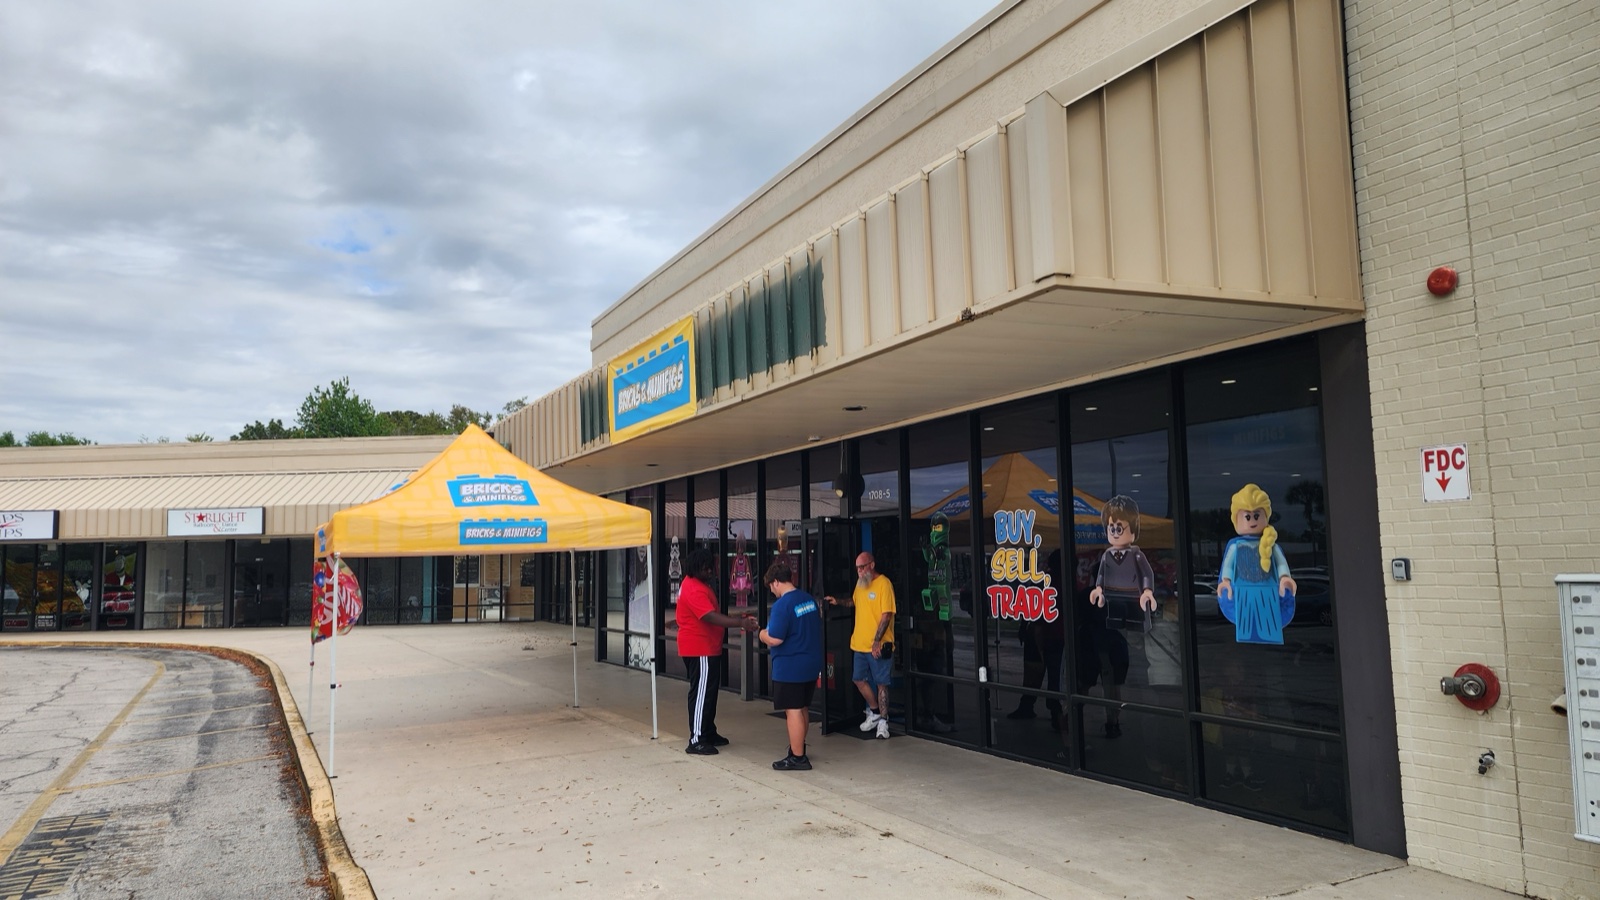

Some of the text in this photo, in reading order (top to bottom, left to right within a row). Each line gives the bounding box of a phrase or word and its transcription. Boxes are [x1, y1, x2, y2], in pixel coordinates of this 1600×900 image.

[618, 361, 684, 415] BRICKS & MINIFIGS
[1424, 447, 1466, 473] FDC
[460, 482, 524, 496] BRICKS
[474, 494, 527, 503] MINIFIGS
[465, 528, 495, 539] BRICKS
[502, 527, 542, 538] MINIFIGS
[994, 509, 1042, 548] BUY,
[991, 547, 1051, 587] SELL,
[987, 585, 1059, 623] TRADE
